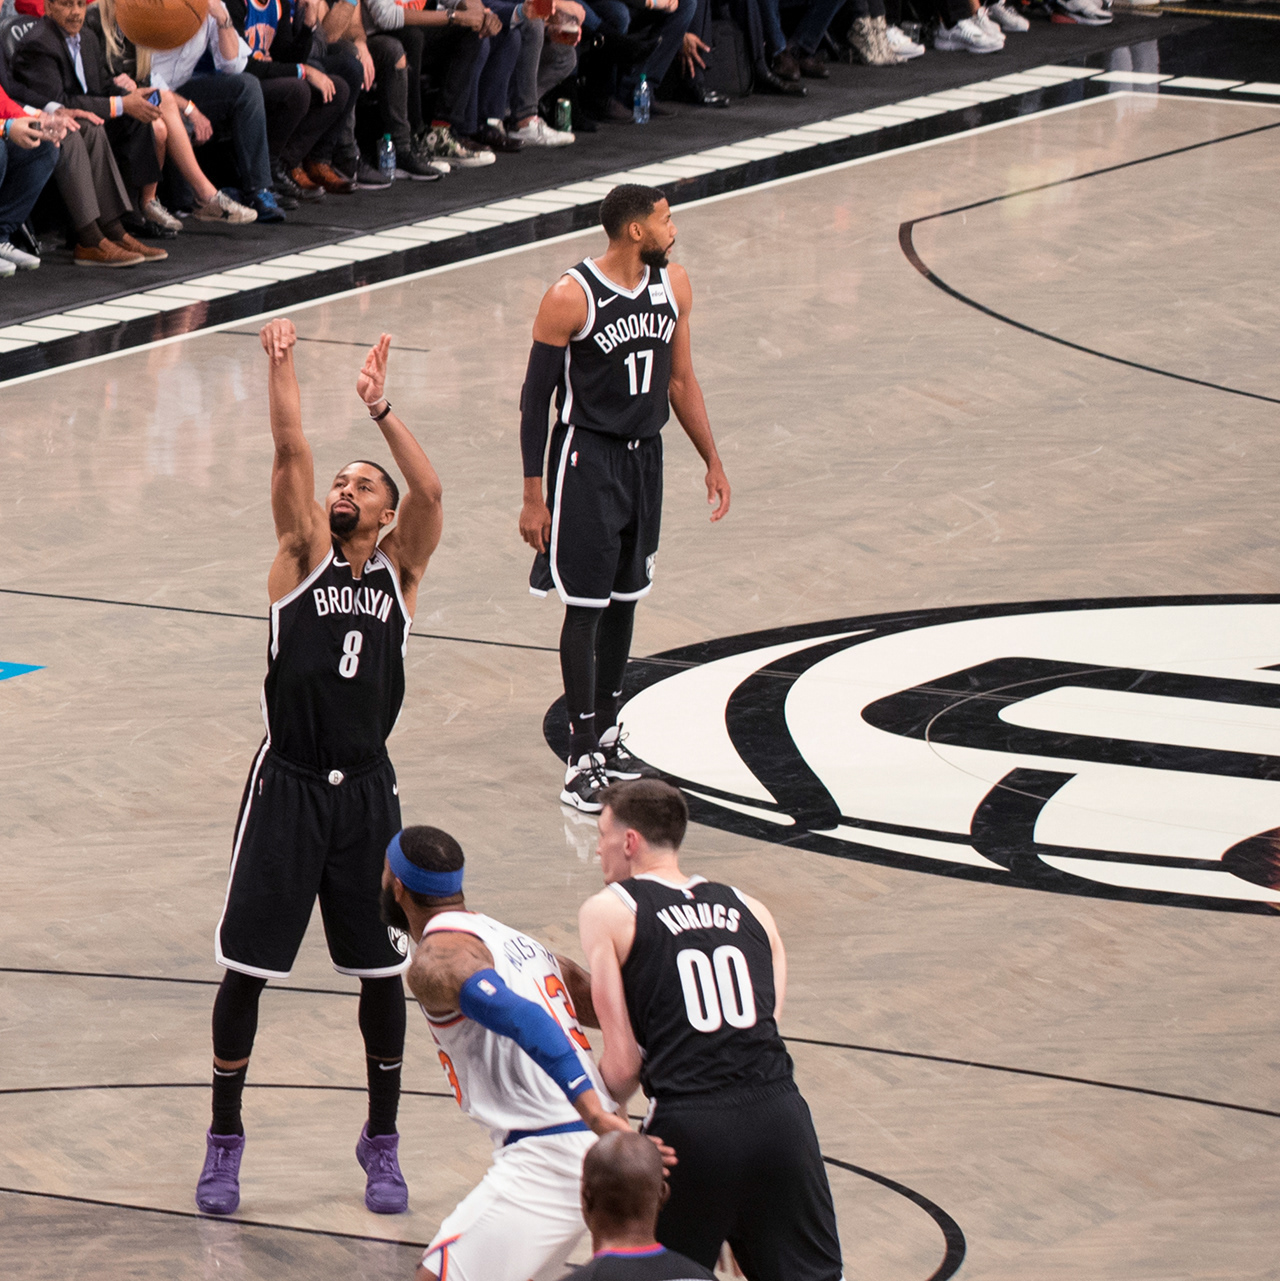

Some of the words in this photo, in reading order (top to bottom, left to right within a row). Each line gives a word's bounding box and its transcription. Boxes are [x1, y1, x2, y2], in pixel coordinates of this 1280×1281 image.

[593, 312, 676, 355] BROOKLYN
[624, 348, 654, 396] 17
[312, 585, 394, 624] BROKLYN
[338, 629, 363, 679] 8
[656, 903, 741, 936] KURUCS
[676, 944, 757, 1034] 00
